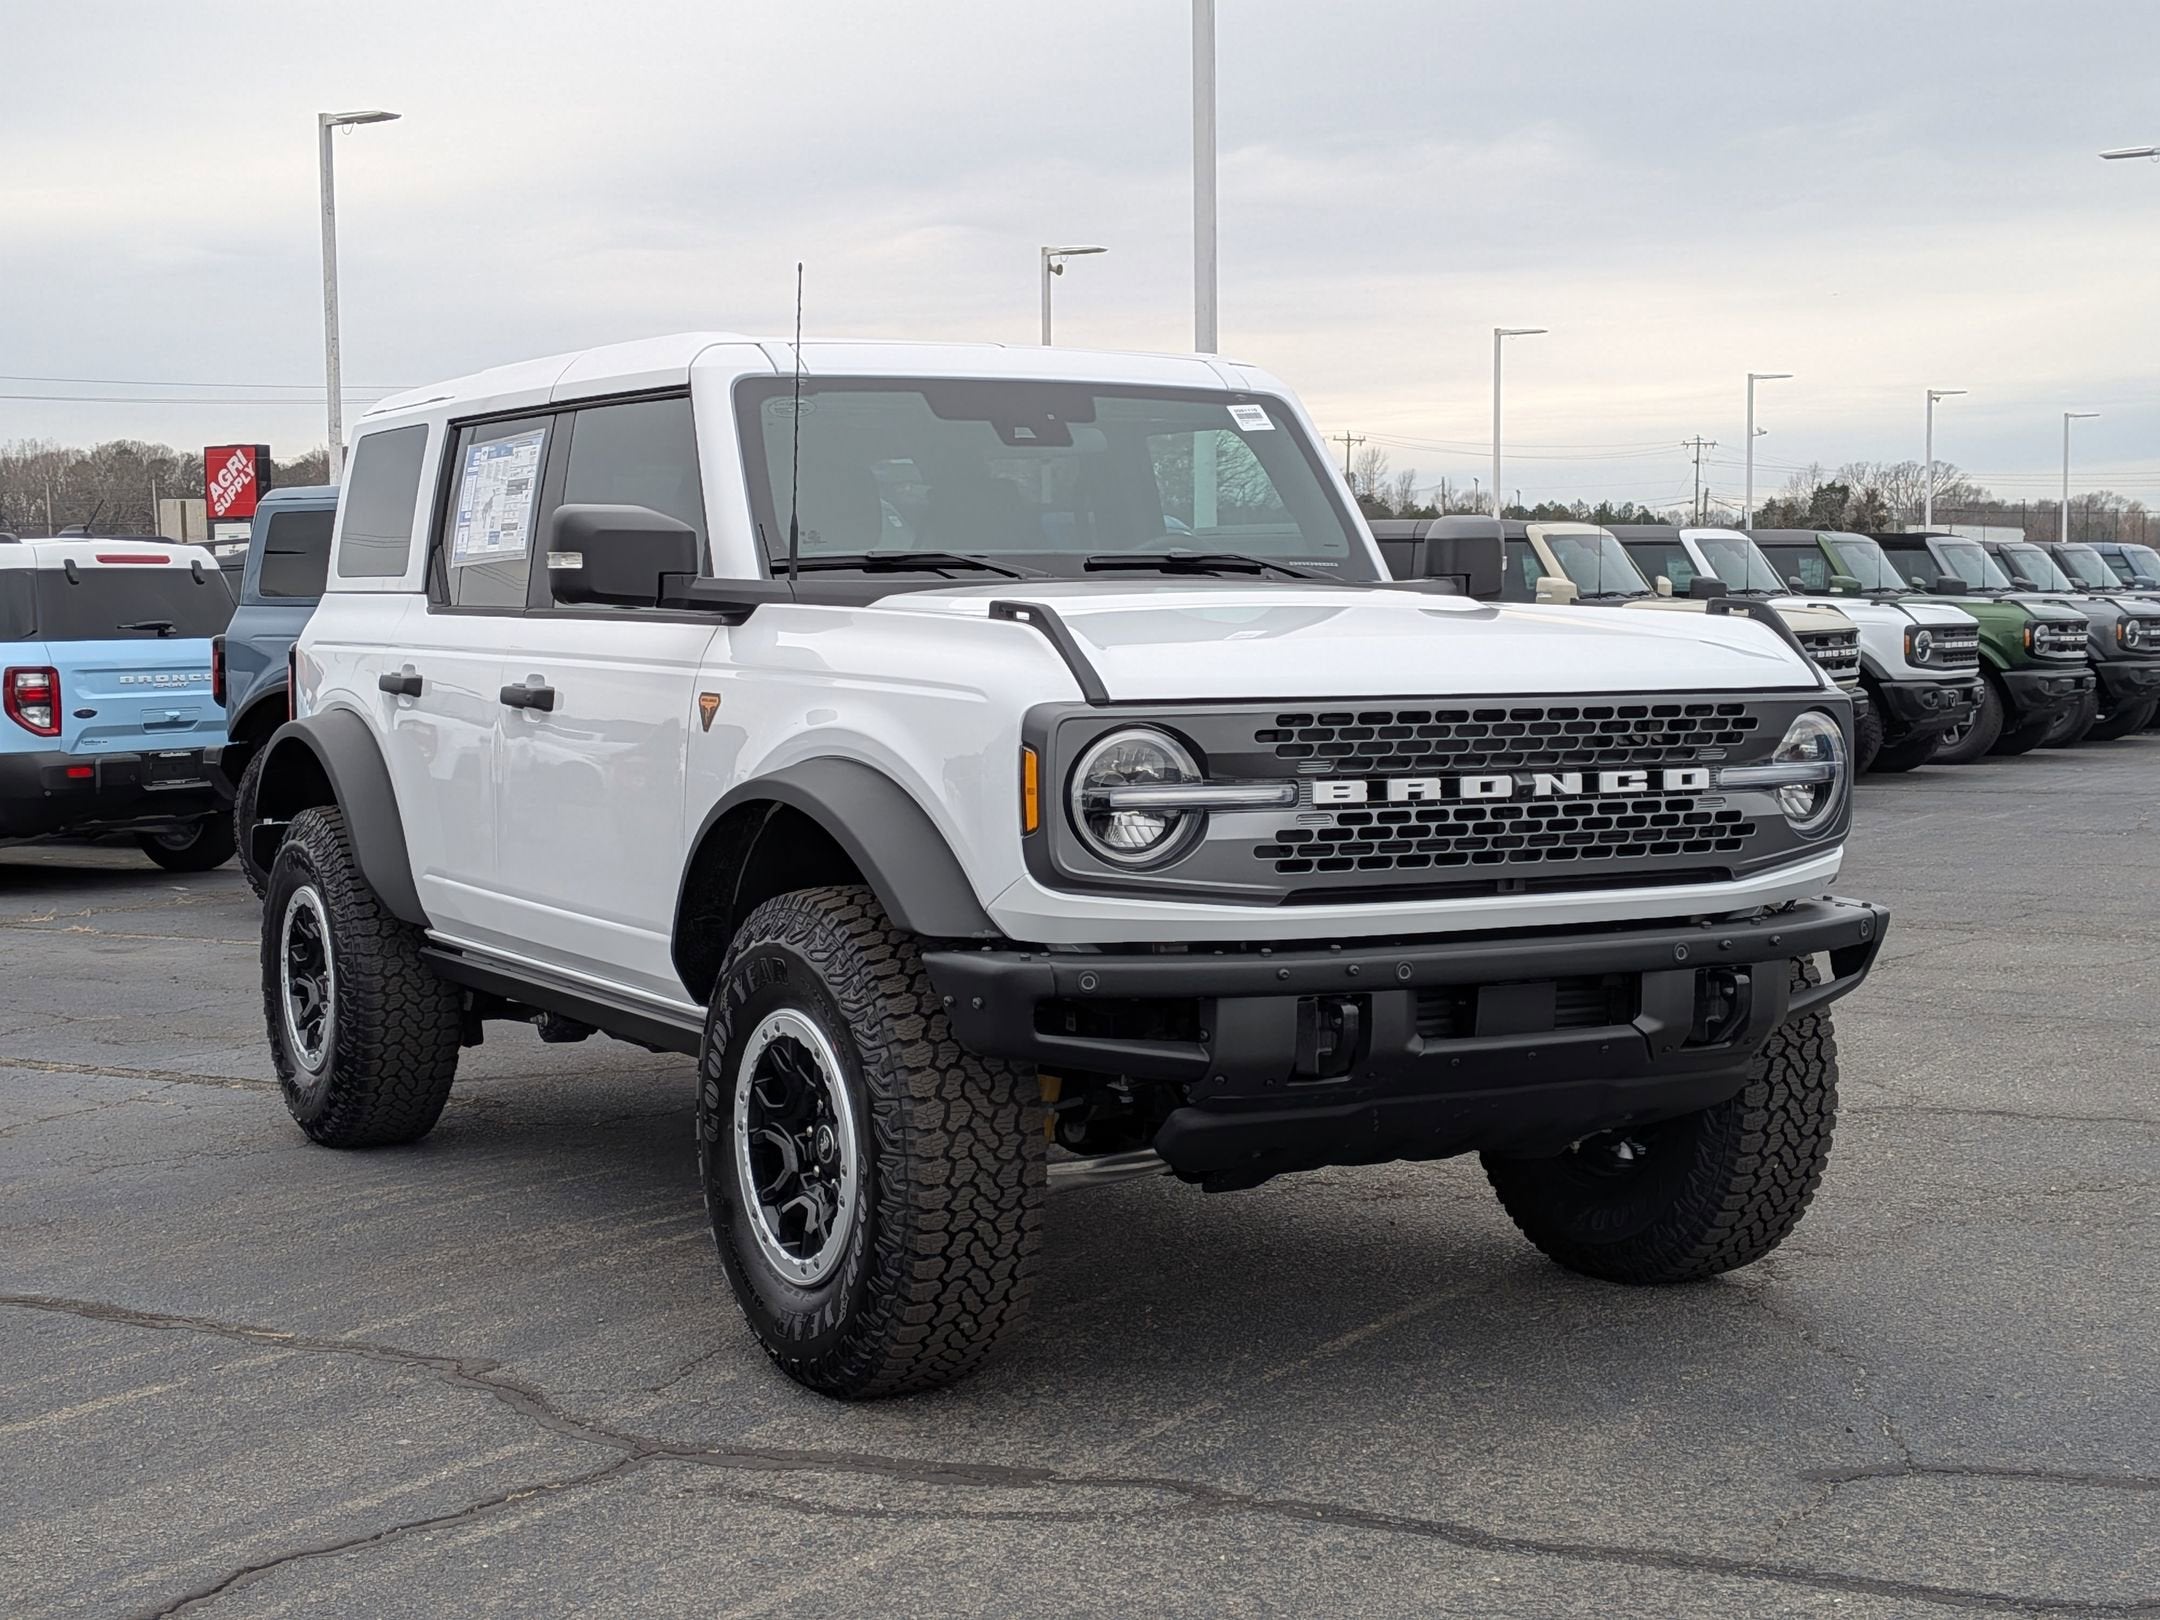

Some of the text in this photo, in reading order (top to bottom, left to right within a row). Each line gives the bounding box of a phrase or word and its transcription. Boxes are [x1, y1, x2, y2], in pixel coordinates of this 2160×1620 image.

[209, 448, 248, 502] AGRI
[214, 460, 256, 516] SUPPLY
[1312, 767, 1710, 804] BRONCO
